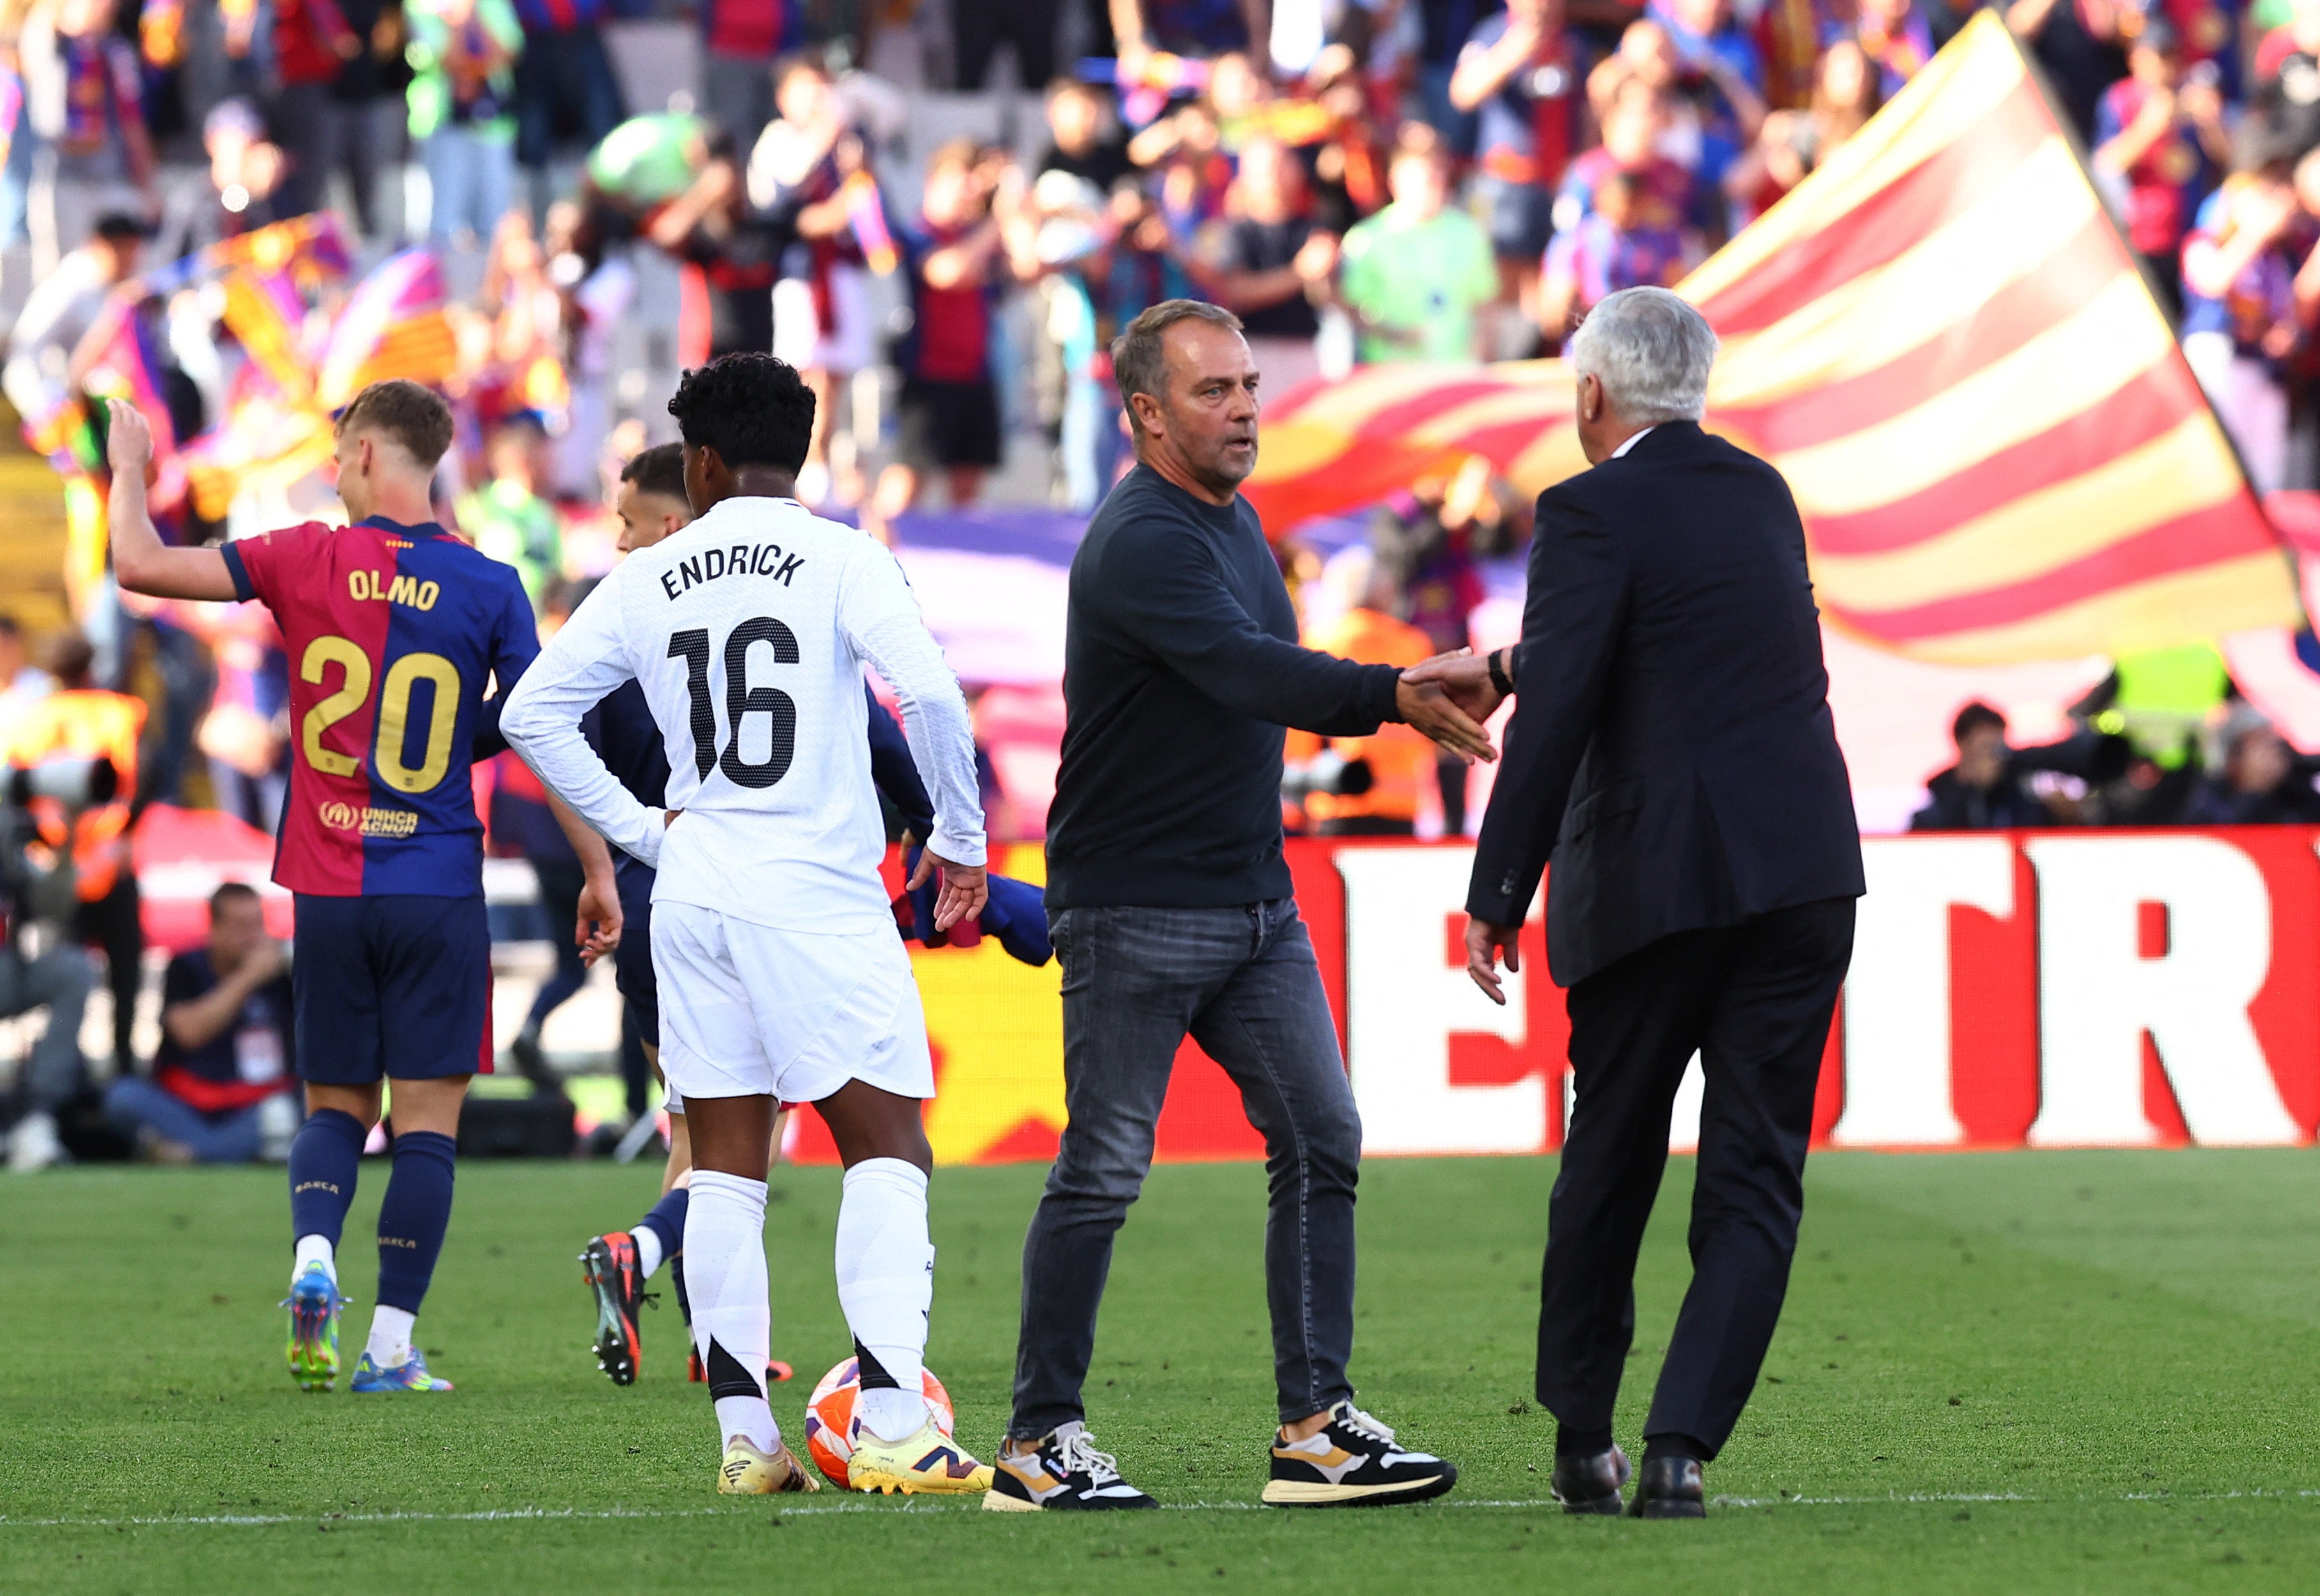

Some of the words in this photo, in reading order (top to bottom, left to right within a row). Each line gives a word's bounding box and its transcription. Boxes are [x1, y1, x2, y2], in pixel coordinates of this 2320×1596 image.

[348, 569, 441, 611] OLMO
[660, 544, 805, 601] ENDRICK
[300, 635, 461, 793] 20
[666, 616, 800, 789] 16
[361, 807, 418, 825] UNHCR
[1333, 835, 2320, 1151] ETR
